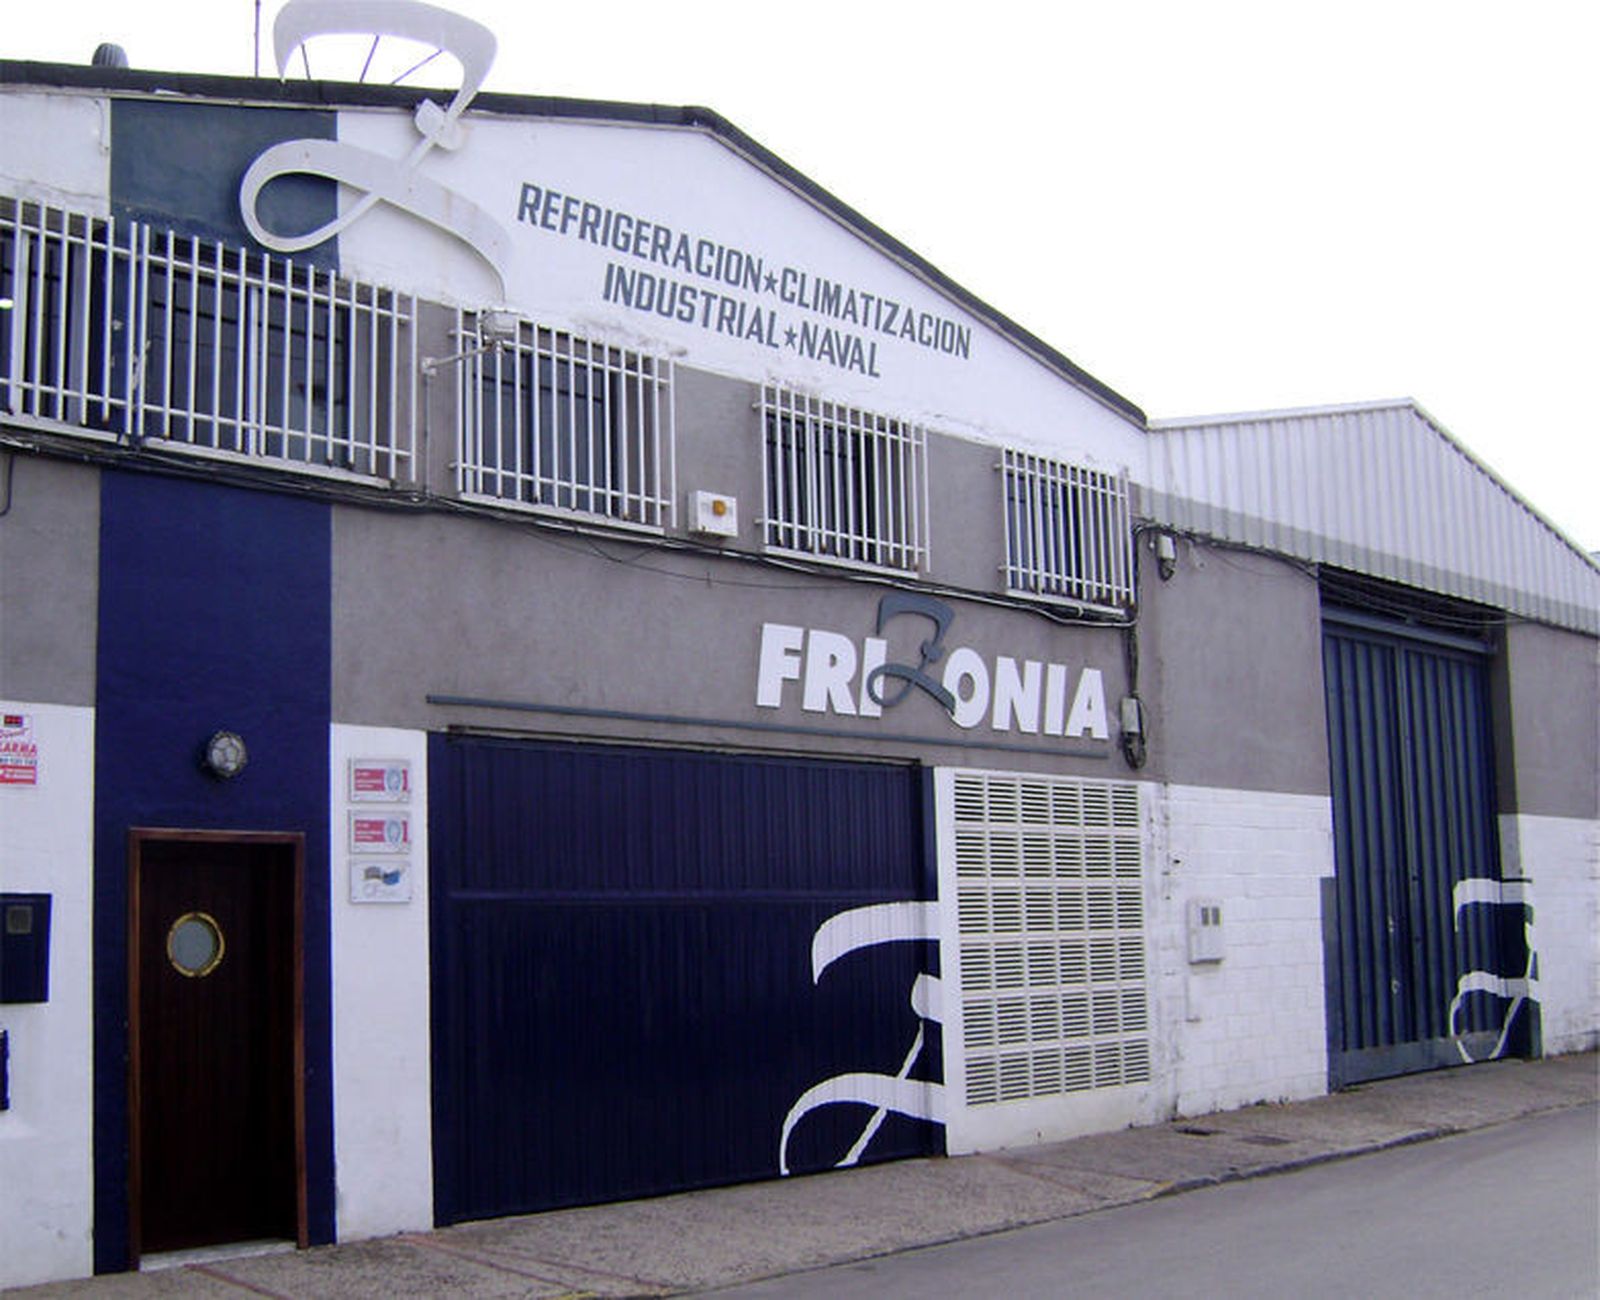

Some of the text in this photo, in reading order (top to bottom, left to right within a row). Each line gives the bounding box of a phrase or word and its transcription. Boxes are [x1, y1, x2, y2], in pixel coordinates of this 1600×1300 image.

[518, 182, 972, 361] REFRIGERACION CLIMATIZACION
[602, 262, 881, 378] INDUSTRIAL NAVAL
